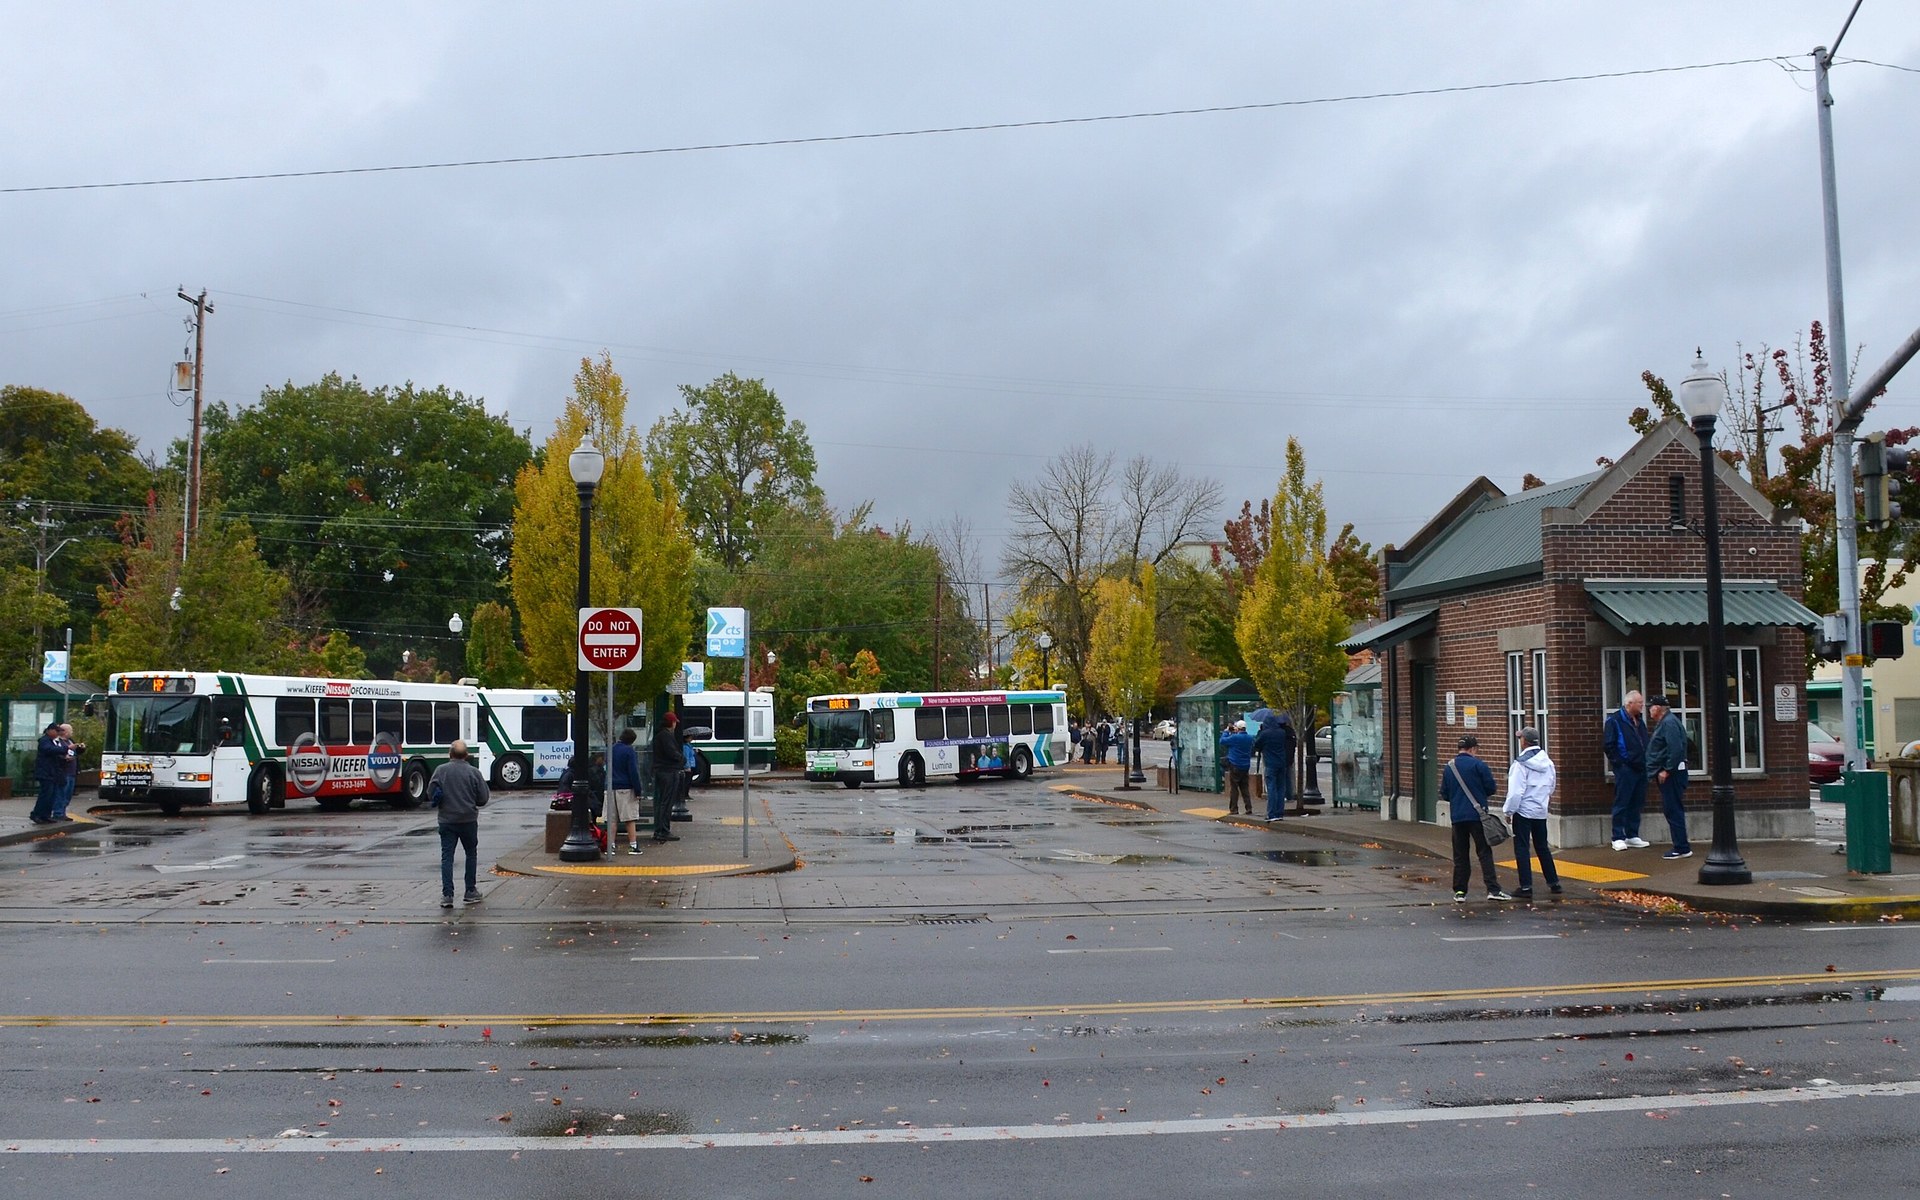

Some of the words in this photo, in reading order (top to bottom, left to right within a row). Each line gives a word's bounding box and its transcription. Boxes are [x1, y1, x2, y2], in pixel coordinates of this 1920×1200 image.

[588, 621, 603, 631] DO
[610, 621, 631, 631] NOT
[725, 626, 741, 635] cts
[593, 648, 627, 658] ENTER
[122, 679, 129, 692] 7
[829, 699, 844, 709] ROUTE
[885, 698, 896, 707] cts
[291, 758, 326, 768] NISSAN
[332, 758, 366, 773] KIEFER
[370, 756, 399, 765] VOLVO
[931, 761, 953, 770] Lumina
